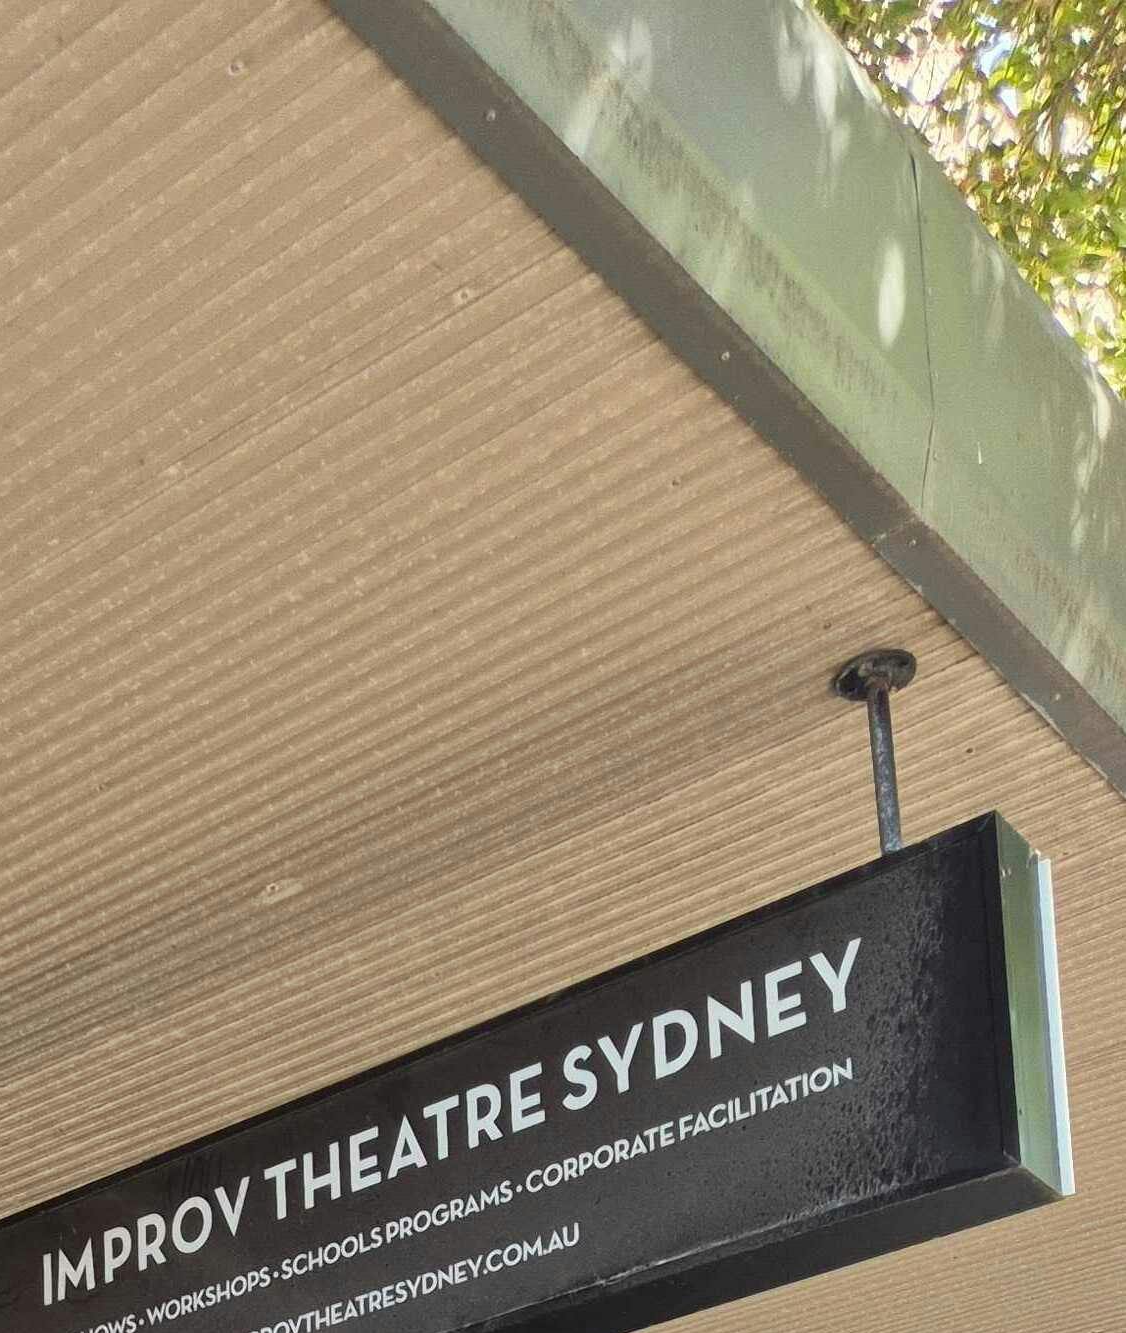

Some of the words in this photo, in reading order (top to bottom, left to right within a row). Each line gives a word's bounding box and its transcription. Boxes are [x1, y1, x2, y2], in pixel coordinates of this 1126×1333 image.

[42, 1176, 250, 1305] IMPROV
[264, 1062, 546, 1221] THEATRE
[561, 937, 862, 1111] SYDNEY
[146, 1269, 272, 1327] WORKSHOPS
[280, 1226, 383, 1281] SCHOOLS
[385, 1181, 513, 1245] PROGRAMS
[525, 1121, 675, 1194] CORPORATE
[679, 1057, 854, 1143] FACILITATION
